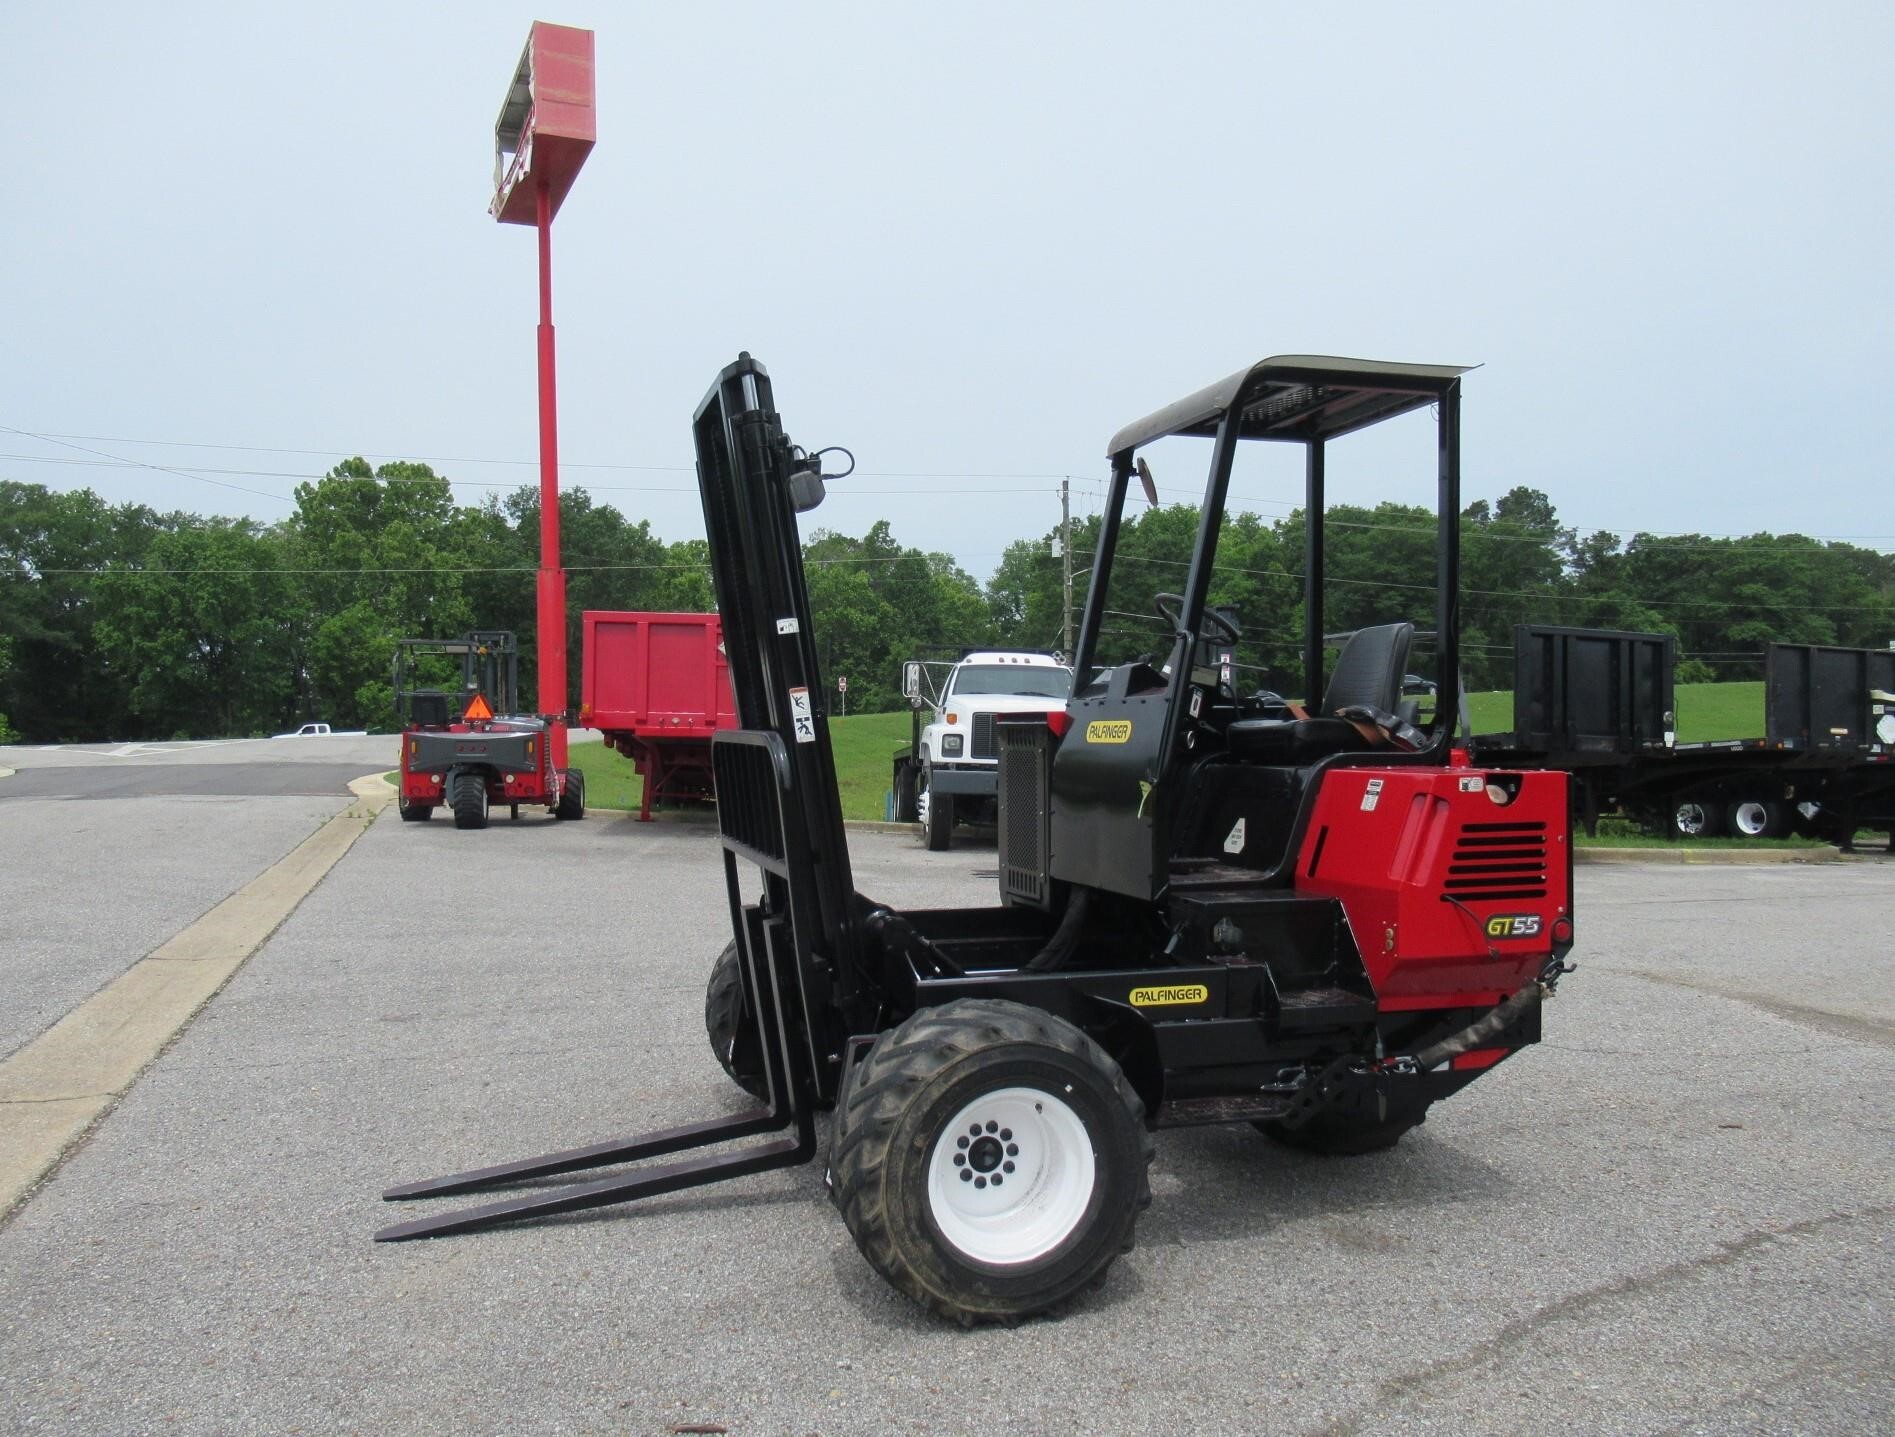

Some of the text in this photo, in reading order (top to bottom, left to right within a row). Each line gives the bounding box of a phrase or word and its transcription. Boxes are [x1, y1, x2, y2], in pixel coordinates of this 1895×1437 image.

[1088, 724, 1129, 739] PALFINGER
[1487, 915, 1541, 936] GT55
[1134, 988, 1201, 1003] PALFINGER
